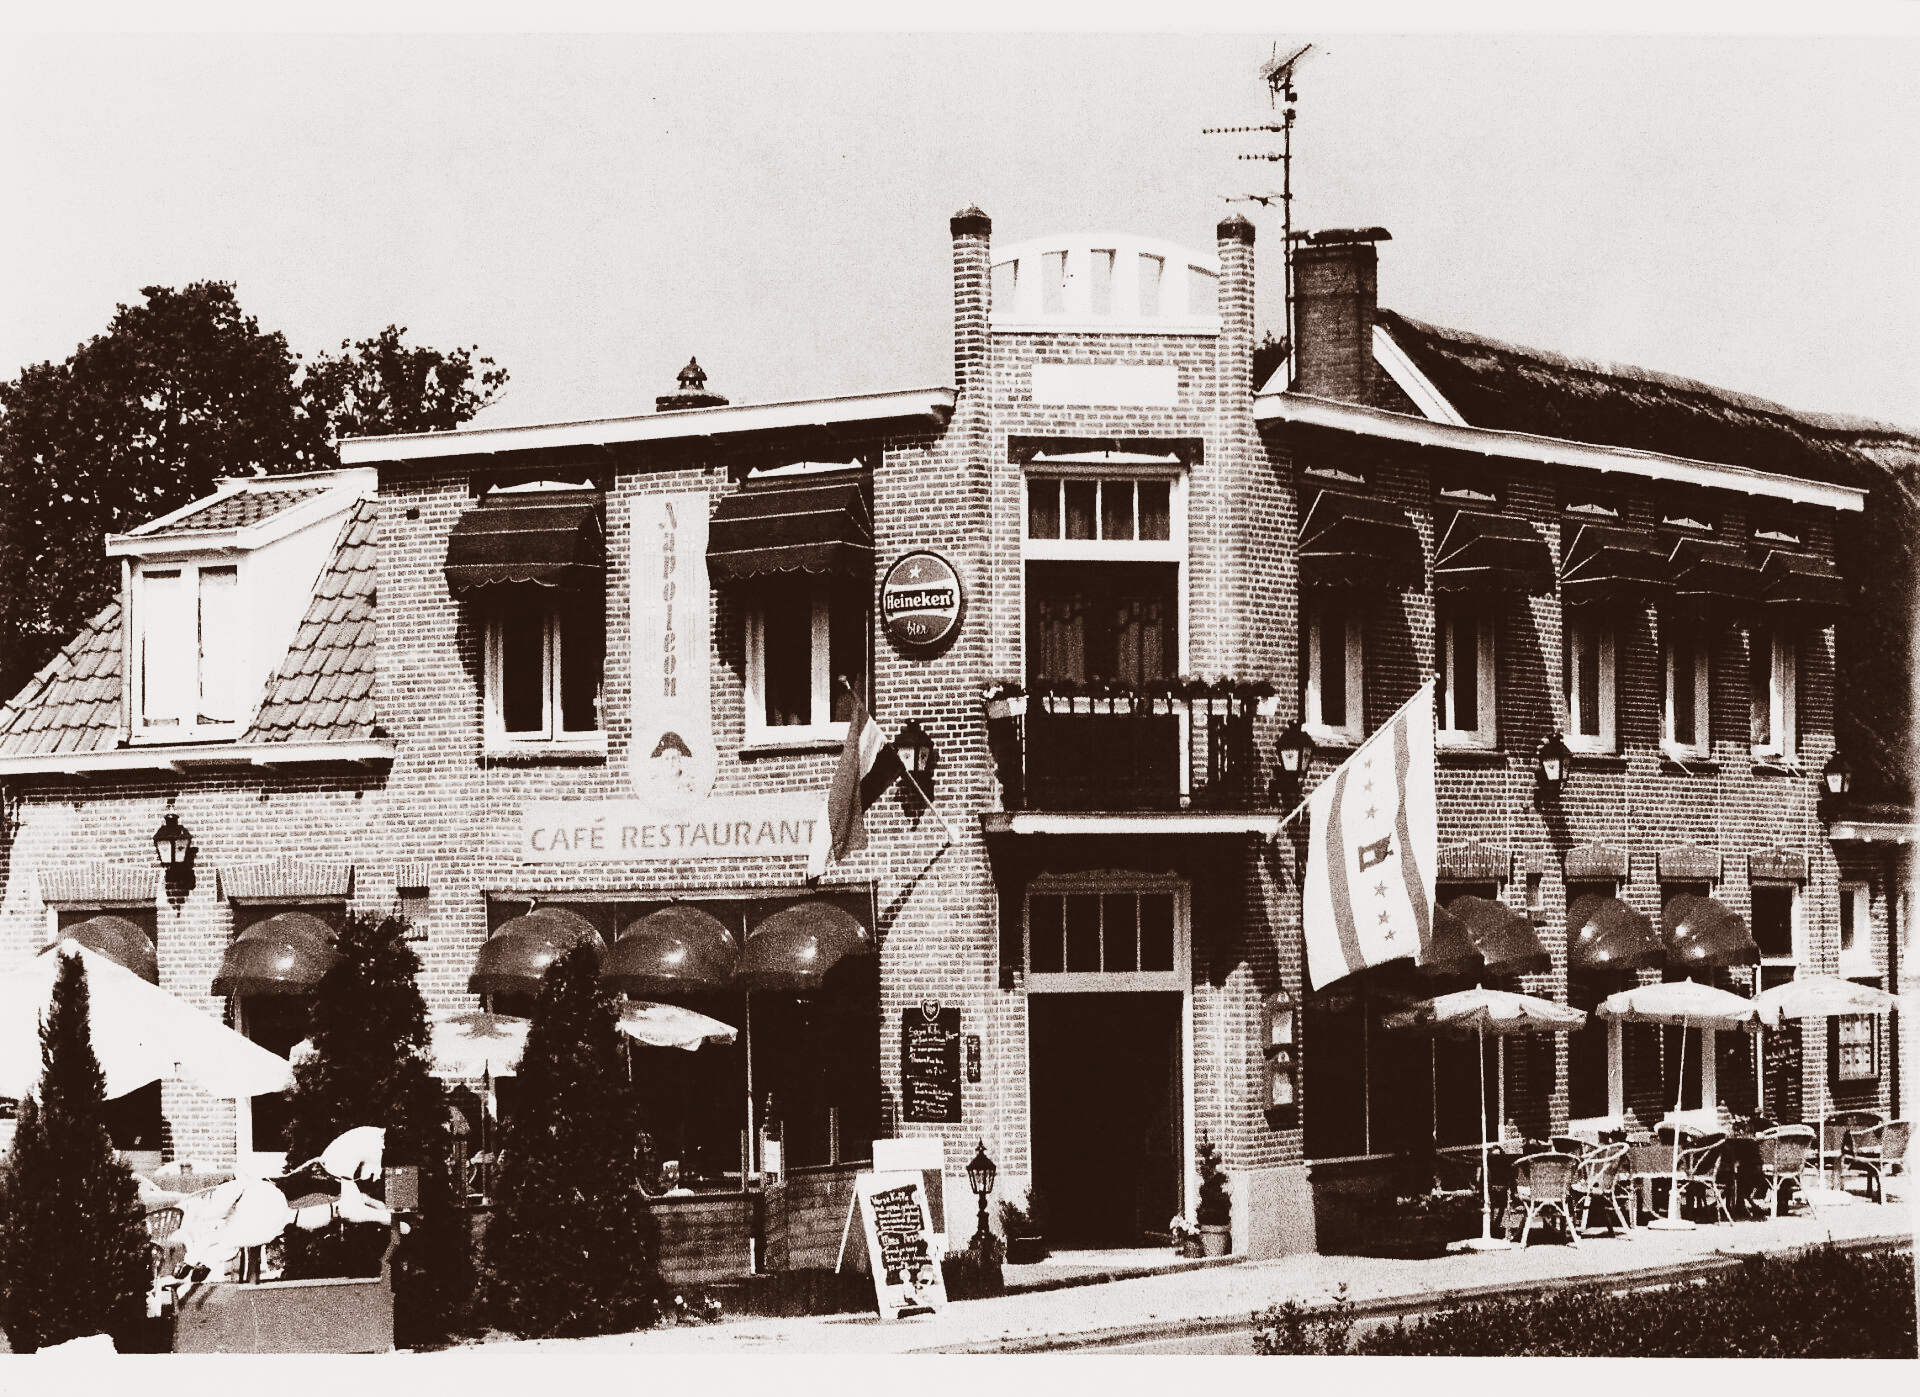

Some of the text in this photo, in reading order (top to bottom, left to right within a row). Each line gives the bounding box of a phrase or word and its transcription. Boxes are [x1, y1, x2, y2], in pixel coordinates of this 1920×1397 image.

[887, 591, 951, 609] Heineken
[907, 621, 929, 635] bier
[531, 817, 818, 852] CAFÉ RESTAURANT
